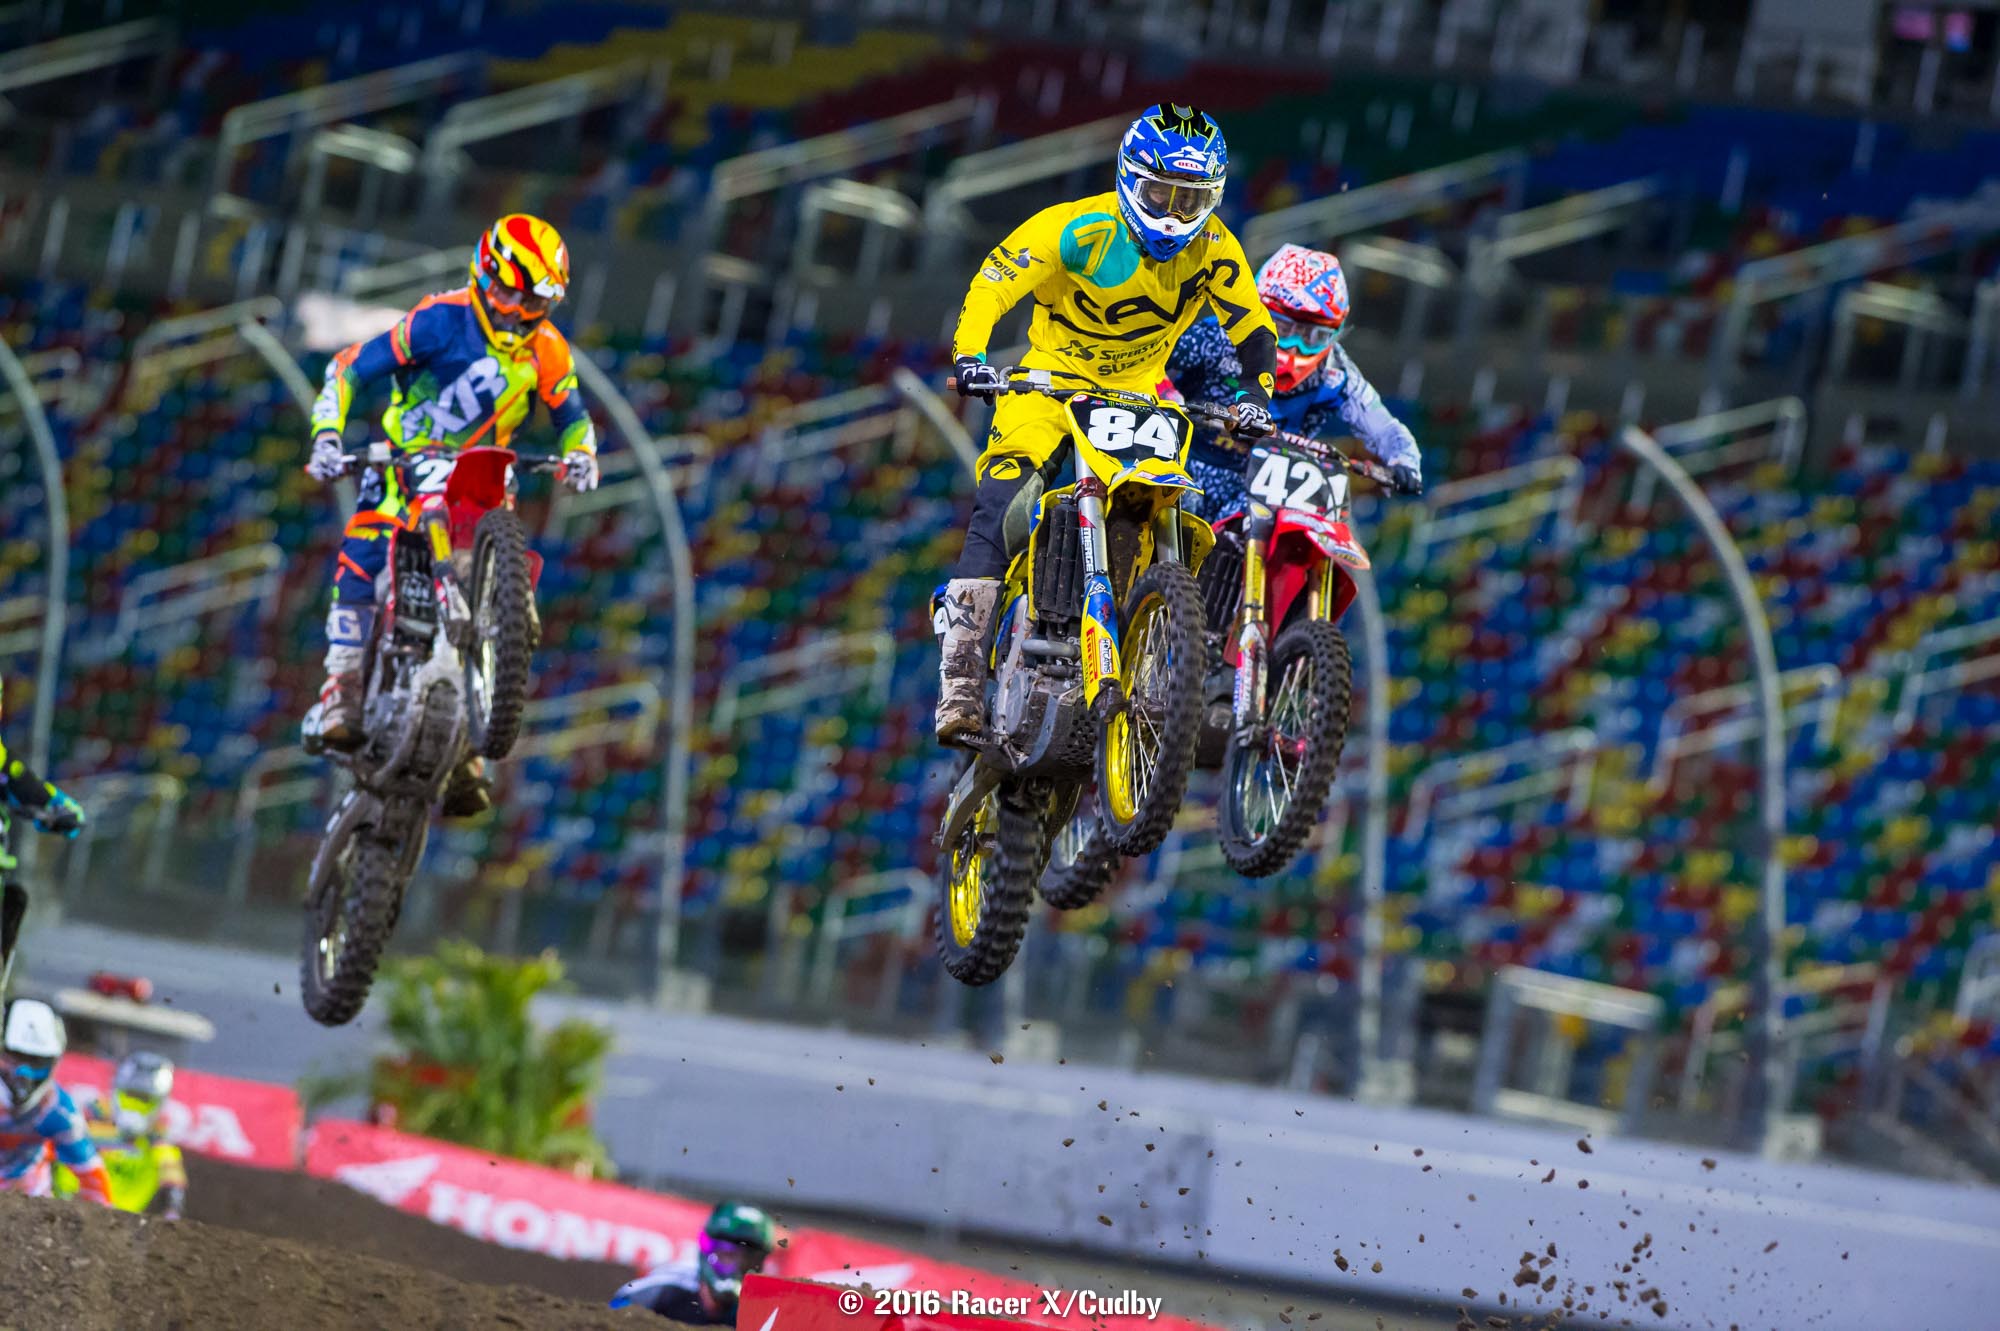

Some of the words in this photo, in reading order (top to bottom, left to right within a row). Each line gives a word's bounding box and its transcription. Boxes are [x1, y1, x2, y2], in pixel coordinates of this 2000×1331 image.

[1178, 161, 1200, 170] BELL
[988, 252, 1018, 281] MOTUL
[1087, 407, 1178, 459] 84
[1250, 453, 1348, 522] 421
[1083, 528, 1094, 572] MERGE
[1086, 626, 1098, 684] PIRELLI
[427, 1181, 688, 1273] HOND
